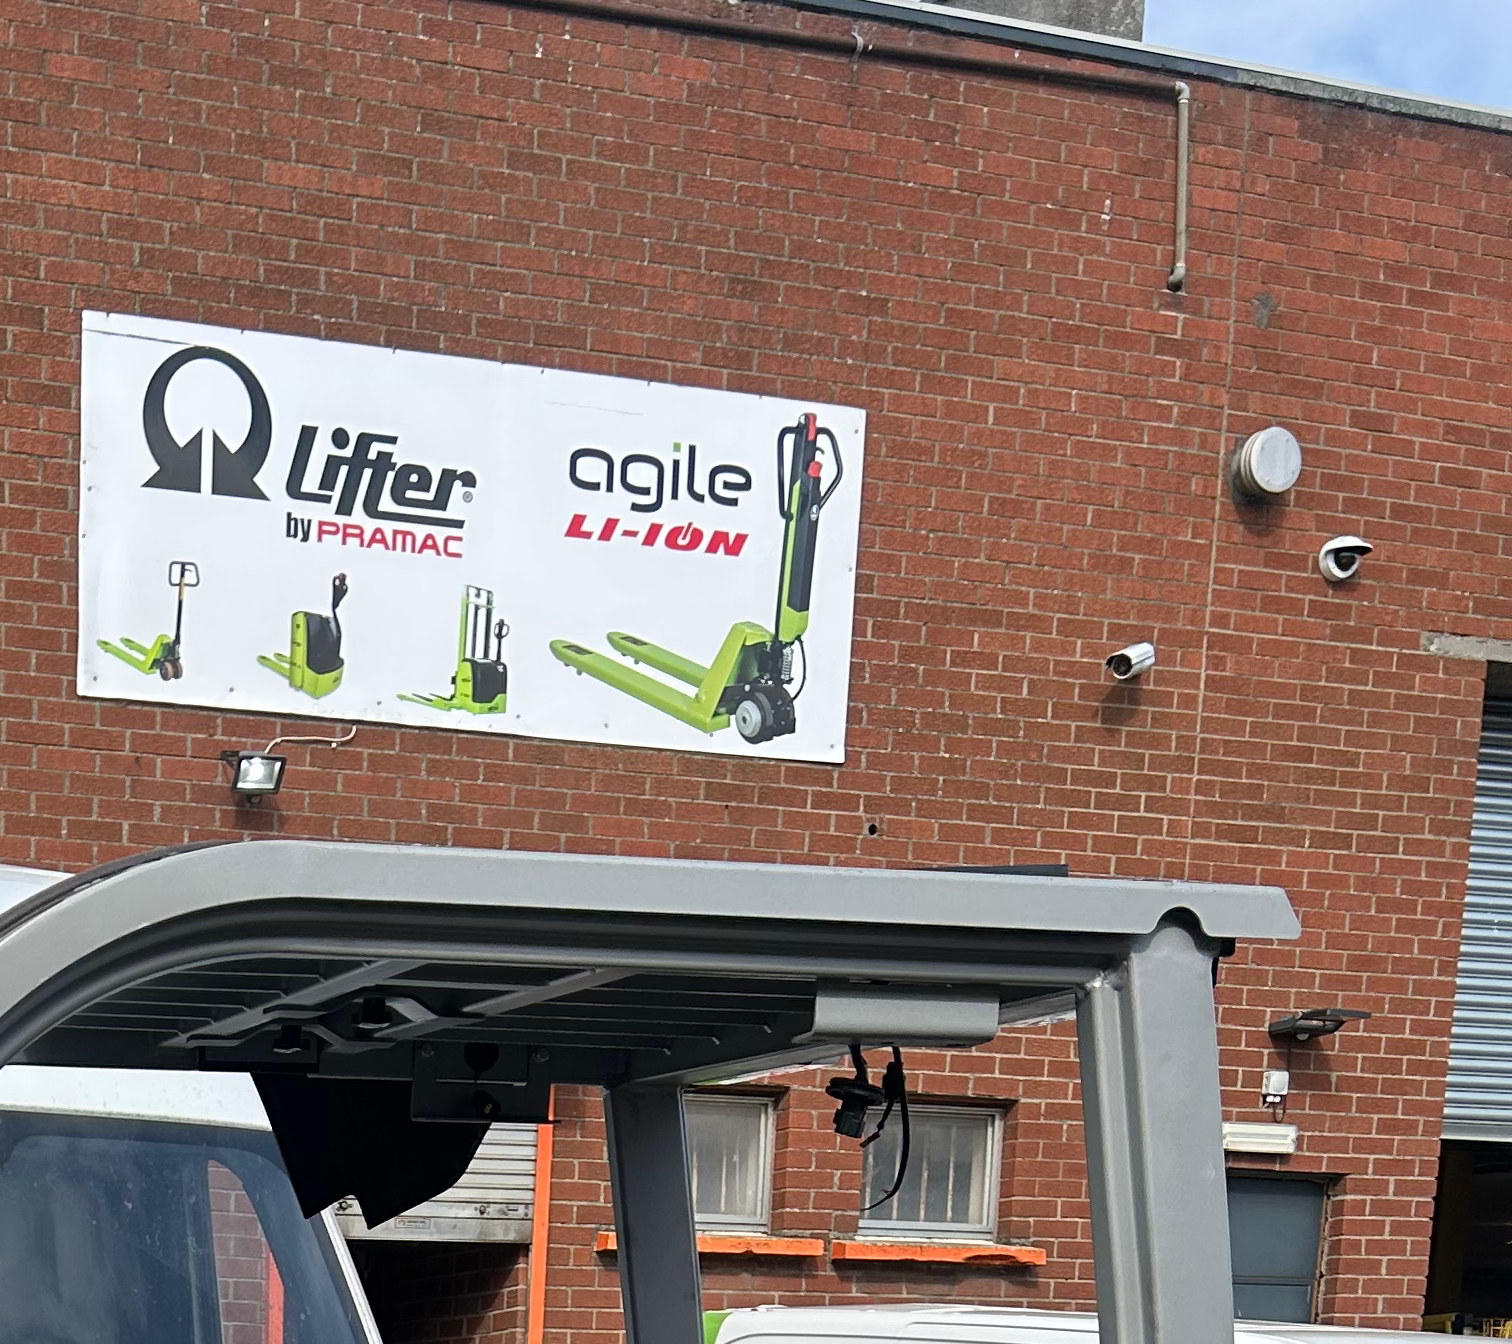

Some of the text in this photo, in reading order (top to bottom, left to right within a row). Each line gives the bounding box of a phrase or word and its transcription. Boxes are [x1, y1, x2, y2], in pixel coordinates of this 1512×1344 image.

[285, 424, 477, 530] Lifter
[569, 441, 753, 513] agile
[286, 511, 464, 559] by PRAMAC
[564, 513, 750, 557] LI-ION
